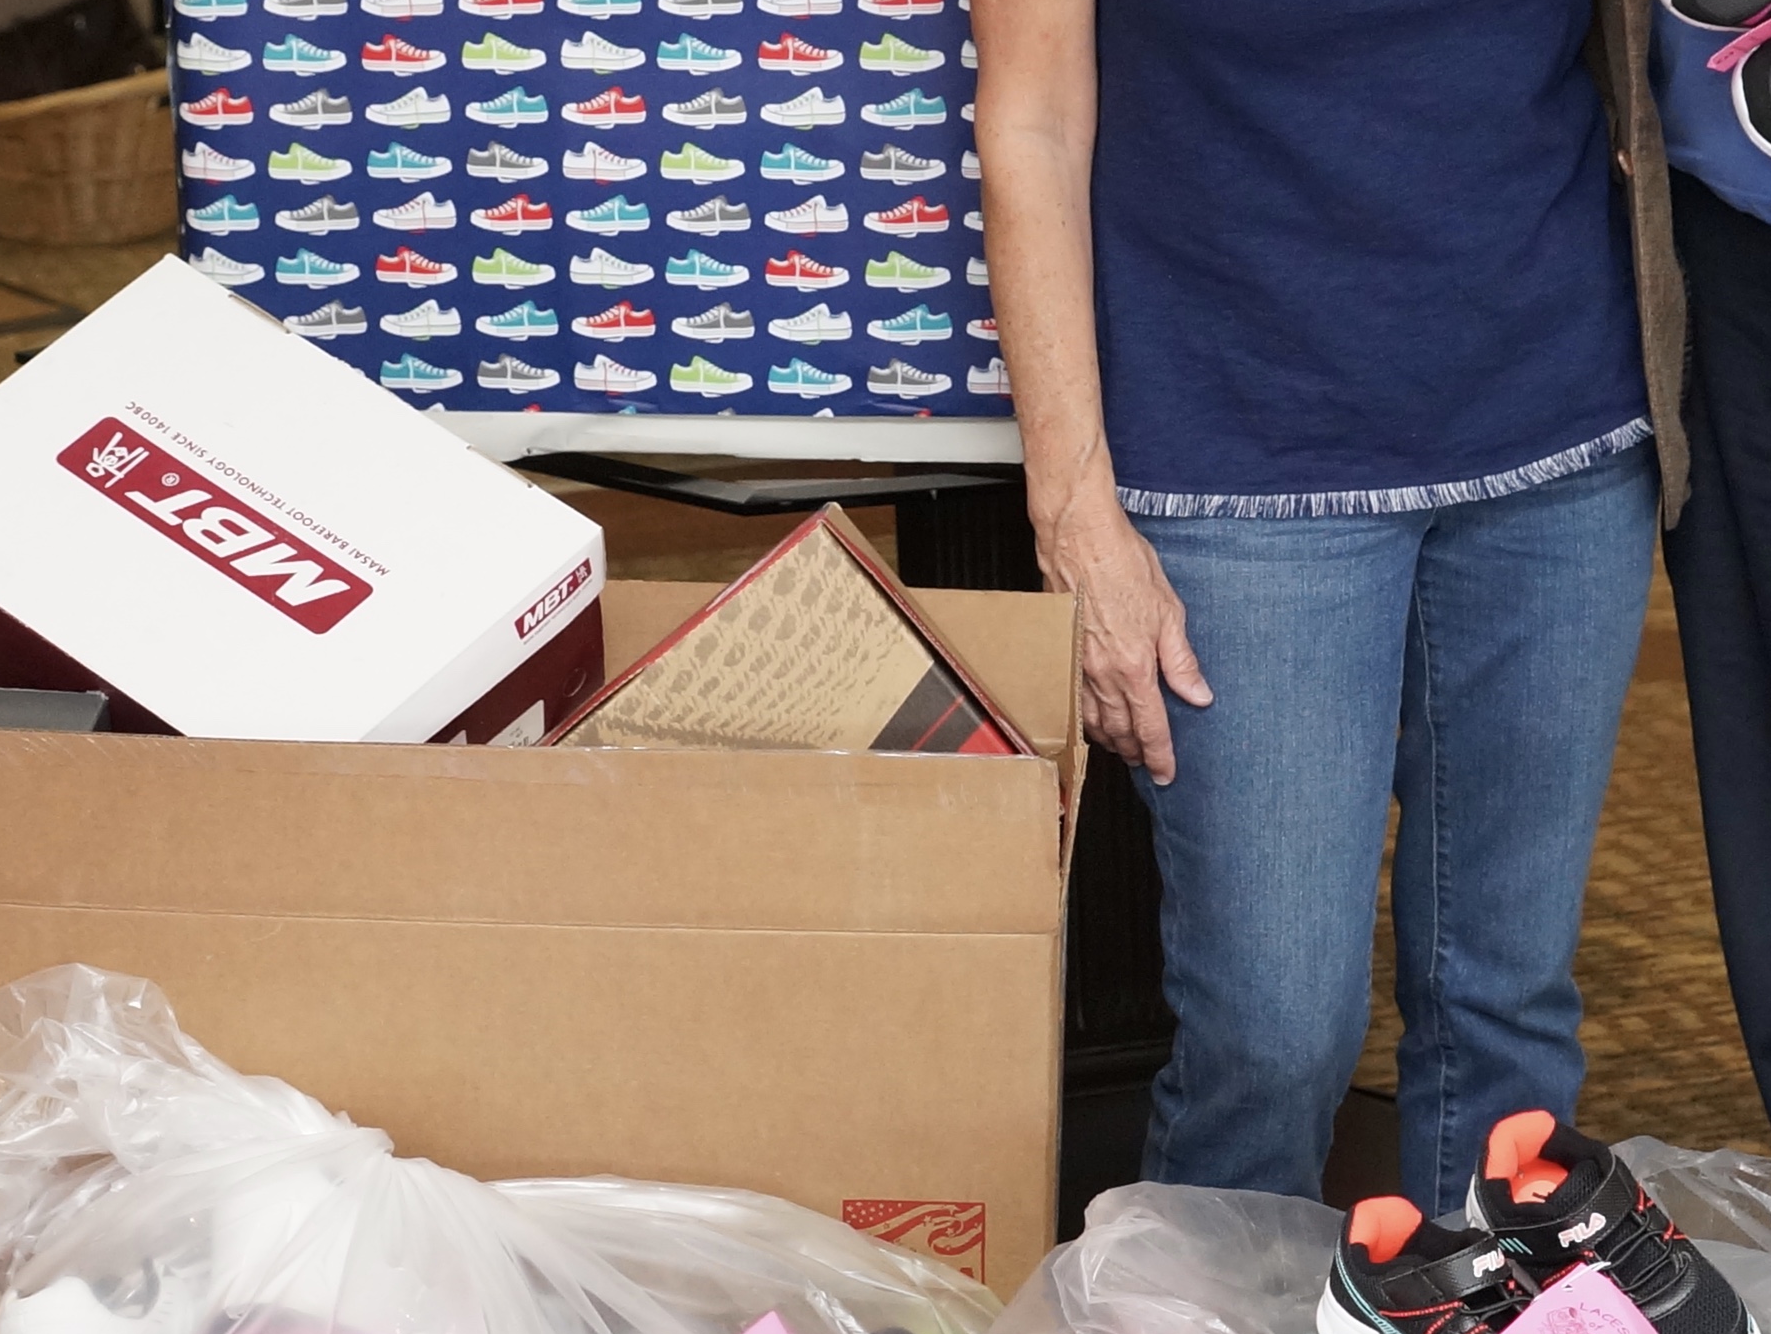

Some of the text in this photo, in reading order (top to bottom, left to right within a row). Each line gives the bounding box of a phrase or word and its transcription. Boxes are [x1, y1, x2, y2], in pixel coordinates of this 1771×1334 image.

[125, 400, 391, 577] MASAI BAREFOOT TECHNOLOGY SINCE 1400BC
[1557, 1212, 1607, 1248] FILA
[1588, 1322, 1604, 1332] of
